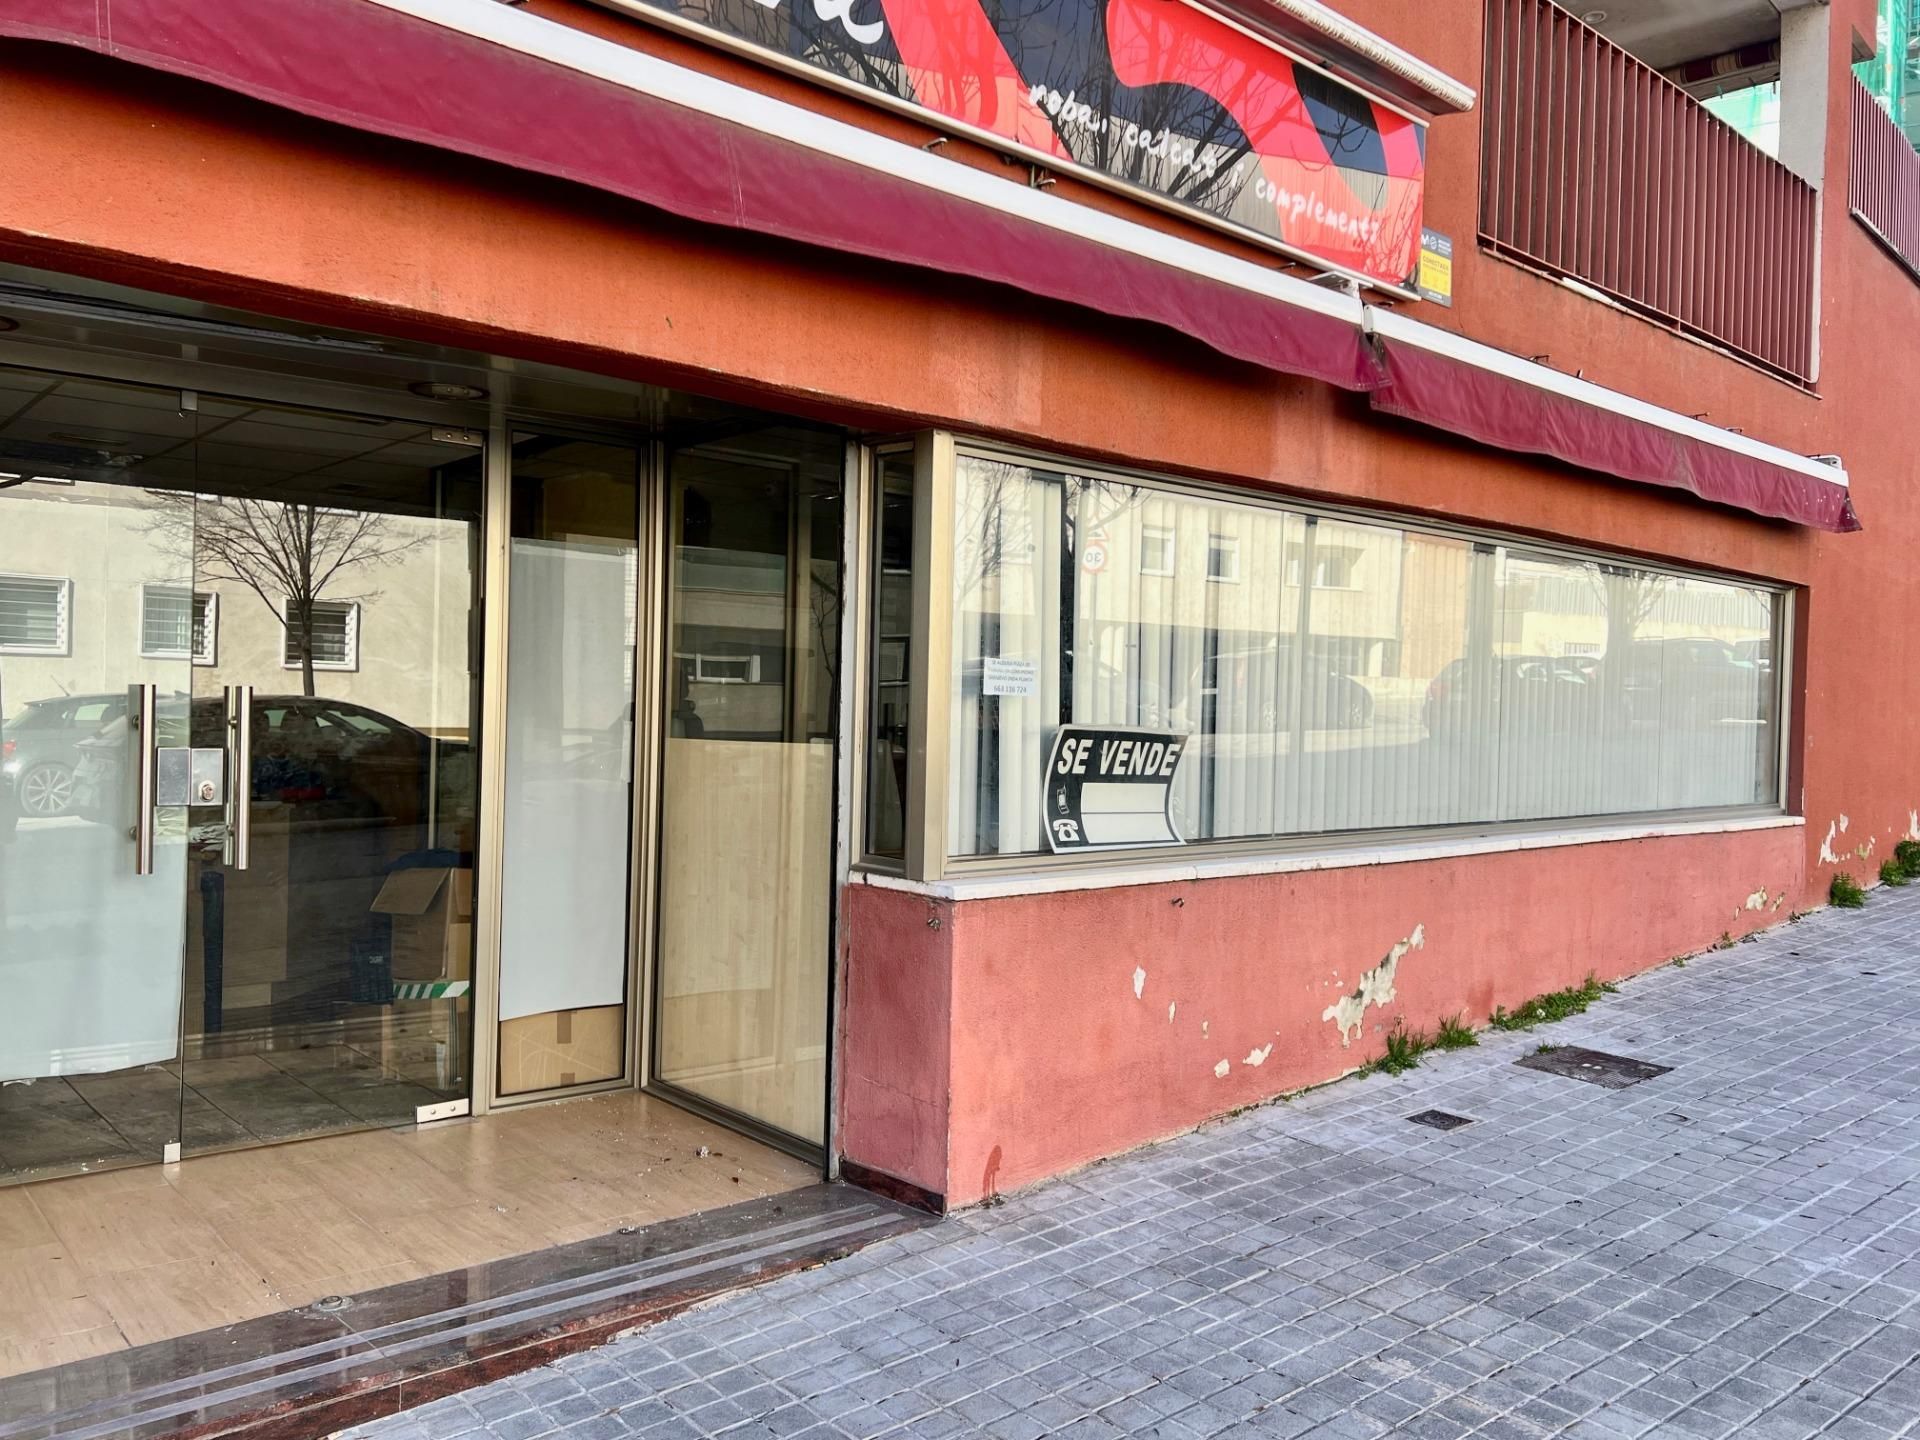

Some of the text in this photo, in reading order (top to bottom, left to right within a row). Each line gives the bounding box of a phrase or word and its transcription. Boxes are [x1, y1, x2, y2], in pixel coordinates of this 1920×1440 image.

[1255, 177, 1380, 244] complements
[1057, 738, 1182, 776] SE VENDE
